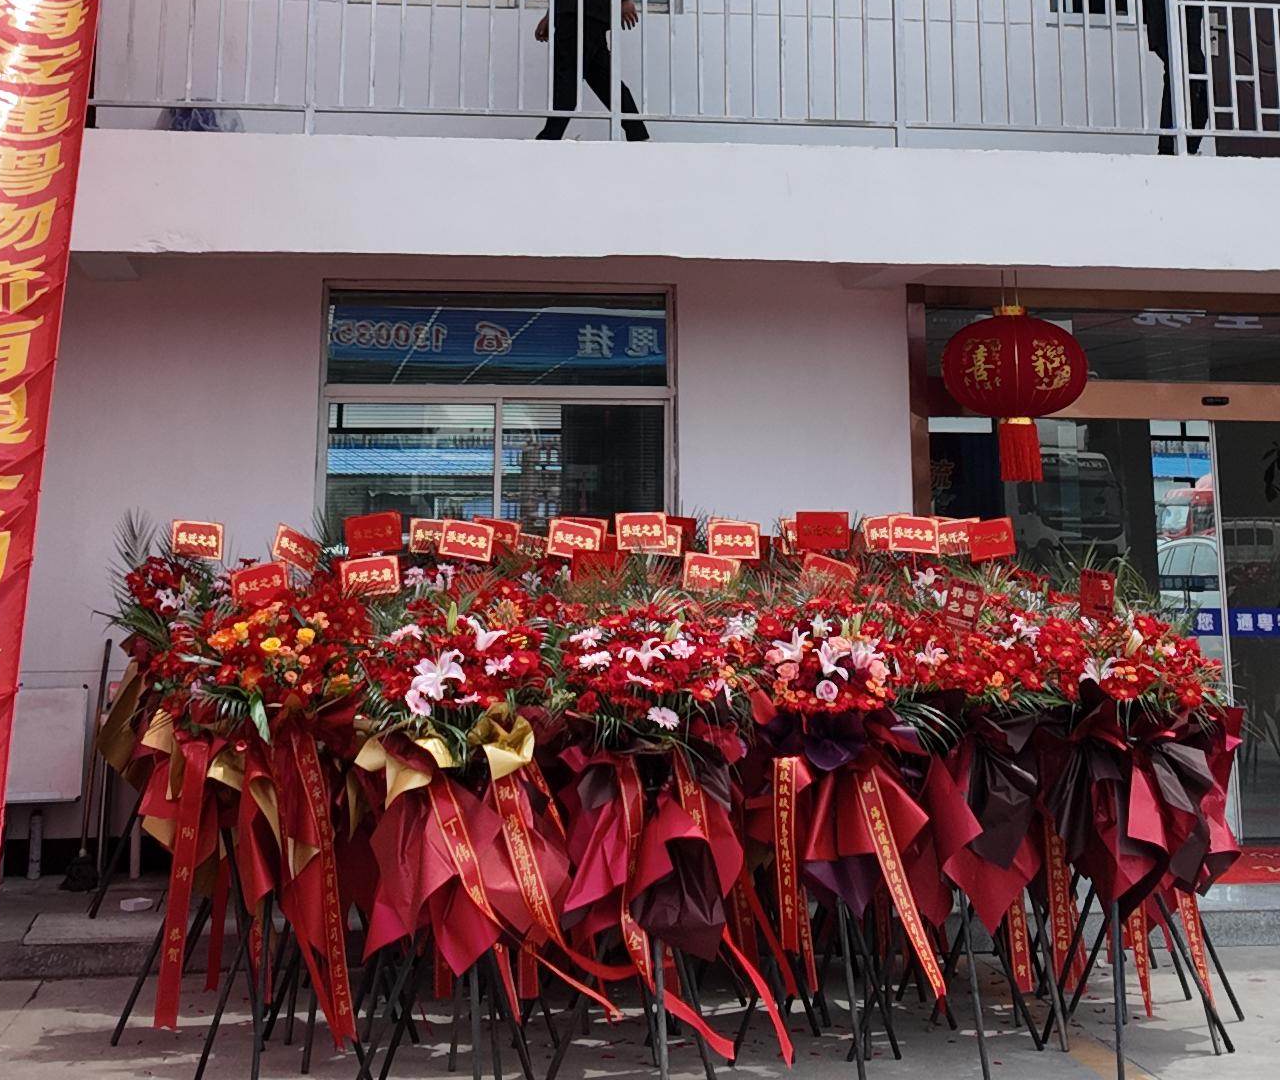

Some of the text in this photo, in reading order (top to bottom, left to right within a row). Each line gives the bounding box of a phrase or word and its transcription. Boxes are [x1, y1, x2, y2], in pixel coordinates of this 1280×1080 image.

[622, 524, 662, 538] 乔迁之喜
[894, 527, 934, 543] 乔迁之喜
[177, 531, 218, 549] 乔迁之喜
[446, 531, 488, 550] 乔迁之喜
[554, 531, 595, 550] 乔迁之喜
[713, 533, 754, 548] 乔迁之喜
